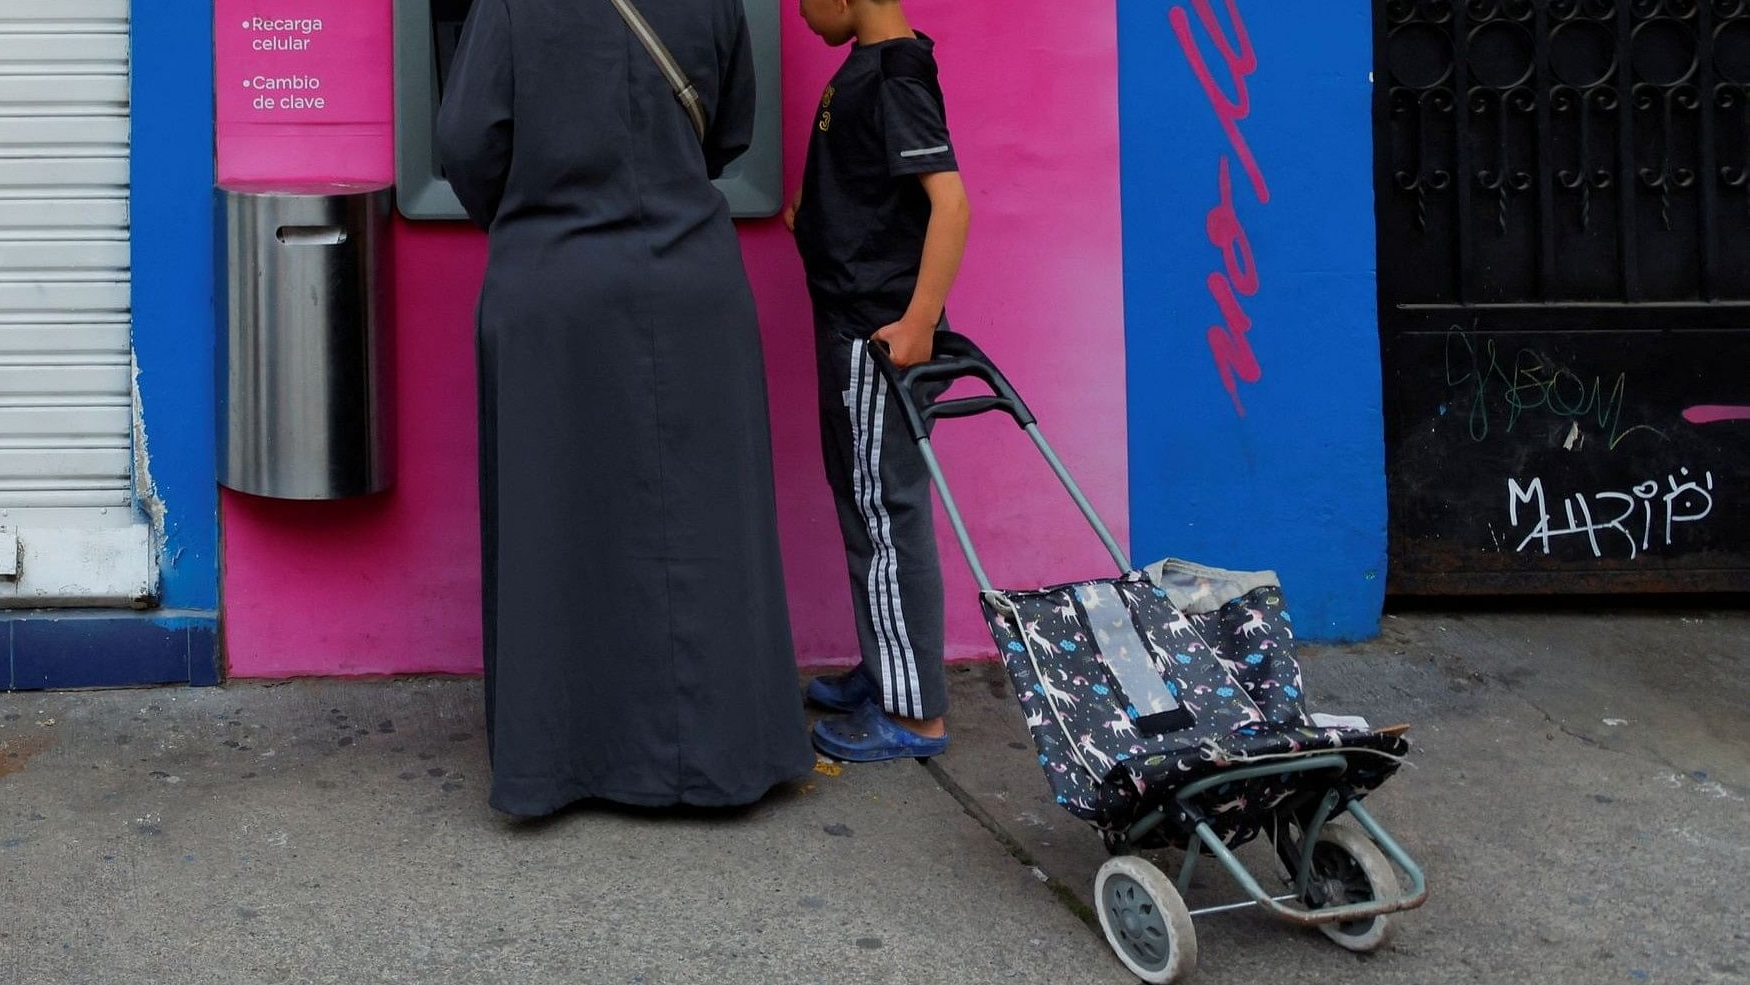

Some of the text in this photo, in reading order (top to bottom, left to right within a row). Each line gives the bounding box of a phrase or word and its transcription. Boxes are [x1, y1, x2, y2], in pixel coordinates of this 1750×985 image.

[252, 17, 323, 34] Recarga
[252, 35, 311, 51] celular
[252, 75, 320, 90] Cambio
[253, 94, 326, 110] de clave
